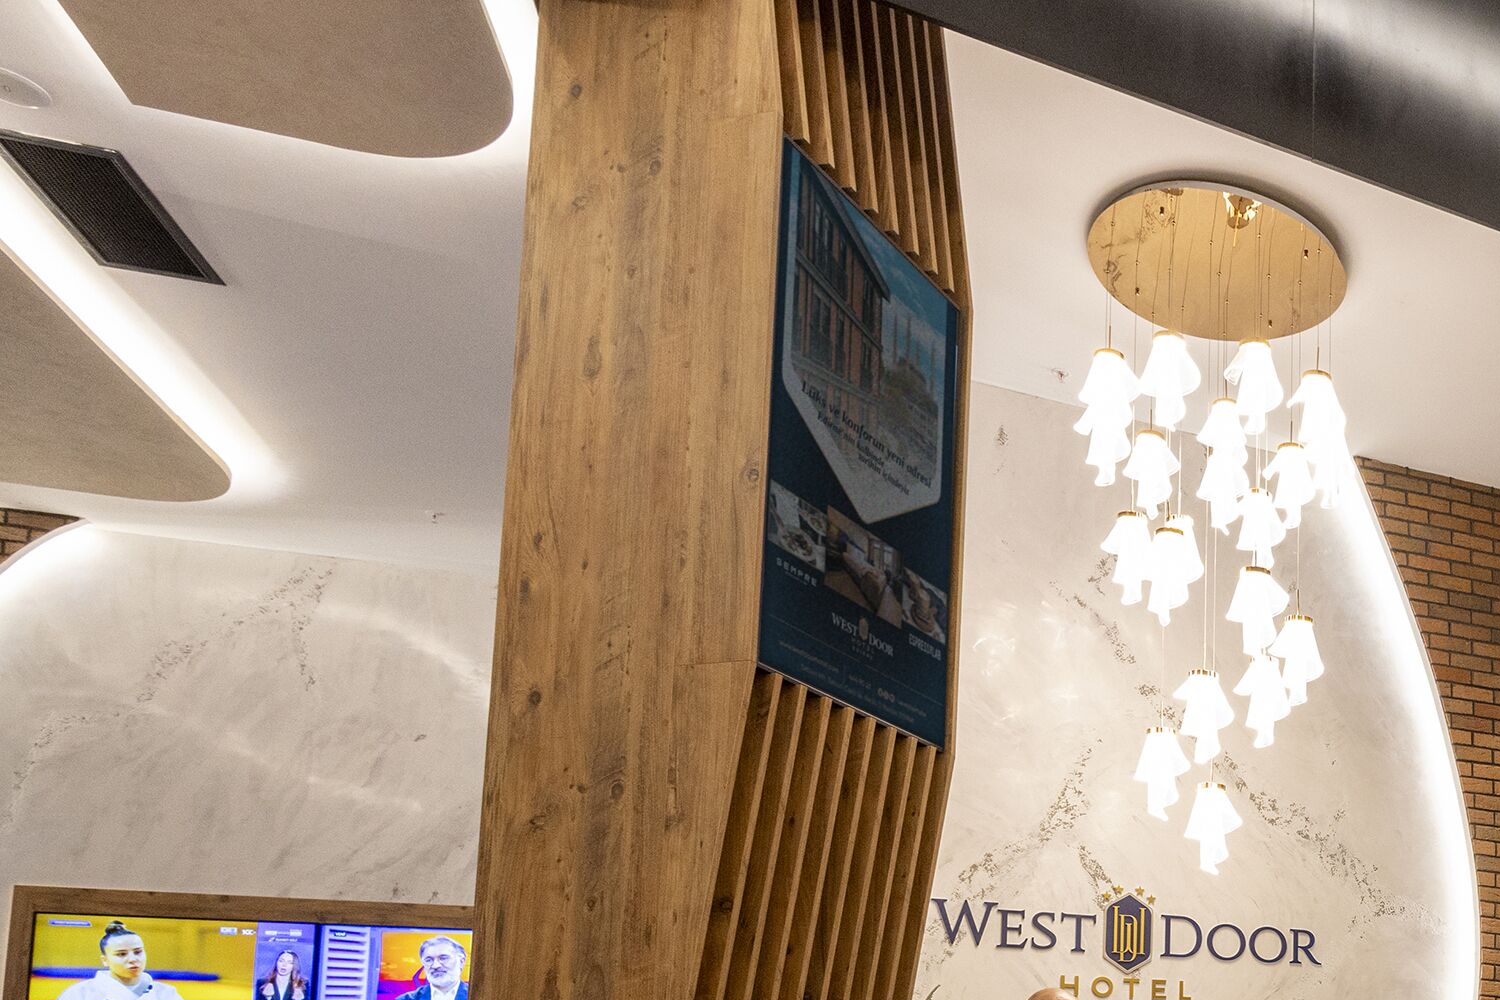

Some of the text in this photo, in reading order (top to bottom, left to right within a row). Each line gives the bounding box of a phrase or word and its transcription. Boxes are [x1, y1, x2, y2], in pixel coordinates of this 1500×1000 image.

[802, 381, 932, 488] Lüks ve konforun yeni adresi
[858, 453, 881, 475] tarihin
[775, 557, 818, 588] SEMPRE
[831, 612, 858, 637] WEST
[869, 633, 894, 657] DOOR
[931, 897, 1322, 967] WEST DOOR
